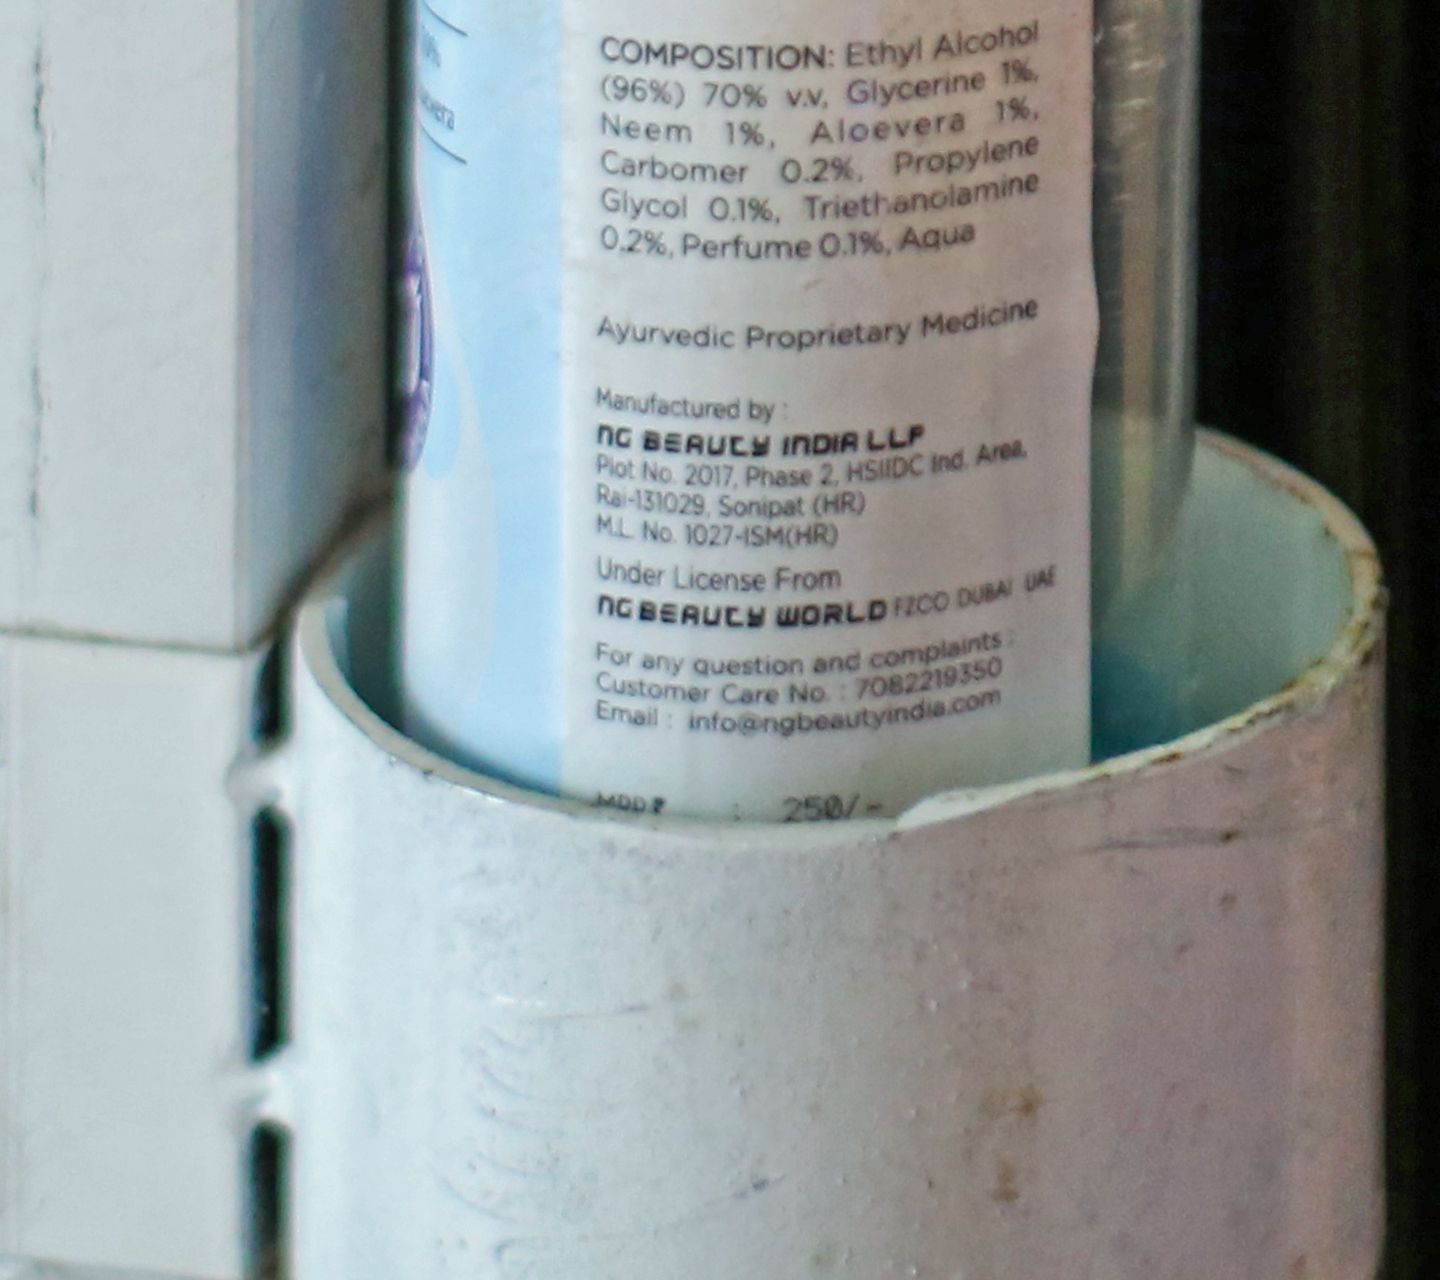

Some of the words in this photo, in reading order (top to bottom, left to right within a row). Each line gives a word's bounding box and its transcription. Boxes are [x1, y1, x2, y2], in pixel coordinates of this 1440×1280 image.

[600, 36, 834, 71] COMPOSITION:
[846, 40, 922, 71] Ethyl
[934, 21, 1039, 59] Alcohol
[601, 75, 685, 109] (96%)
[704, 82, 767, 108] 70%
[846, 67, 986, 108] Glycerine
[1002, 60, 1040, 84] 1%,
[601, 113, 693, 143] Neem
[725, 121, 775, 149] 1%,
[810, 110, 965, 144] Aloevera
[996, 97, 1040, 122] 1%,
[601, 151, 748, 184] Carbomer
[894, 135, 1040, 174] Propylene
[601, 187, 687, 220] Glycol
[709, 195, 781, 224] 0.1%,
[804, 172, 1040, 221] Triethanolamine
[682, 232, 811, 261] Perfume
[818, 231, 892, 258] 0.1%,
[898, 220, 976, 254] Aqua
[597, 316, 735, 348] Ayurvedic
[746, 319, 911, 353] Proprietary
[921, 297, 1039, 337] Medicine
[596, 386, 740, 419] Manufactured
[749, 395, 776, 422] by
[643, 429, 772, 458] BEAUTY
[782, 430, 858, 456] INDIA
[867, 424, 925, 449] LLP
[596, 454, 634, 481] Plot
[746, 464, 812, 488] Phase
[719, 494, 805, 520] Sonipat
[813, 492, 866, 517] (HR)
[598, 560, 665, 585] Under
[674, 566, 766, 592] License
[775, 566, 841, 591] From
[639, 602, 765, 627] BEAUTY
[776, 599, 887, 627] WORLD
[957, 579, 1014, 607] DUBAI
[596, 643, 632, 666] For
[642, 653, 685, 676] any
[693, 652, 803, 677] question
[812, 653, 861, 673] and
[870, 629, 1003, 669] complaints
[596, 671, 710, 702] Customer
[721, 681, 780, 704] Care
[855, 658, 1003, 697] 7082219350
[596, 701, 659, 726] Email
[689, 686, 1001, 735] info@ngbeautyindia.com
